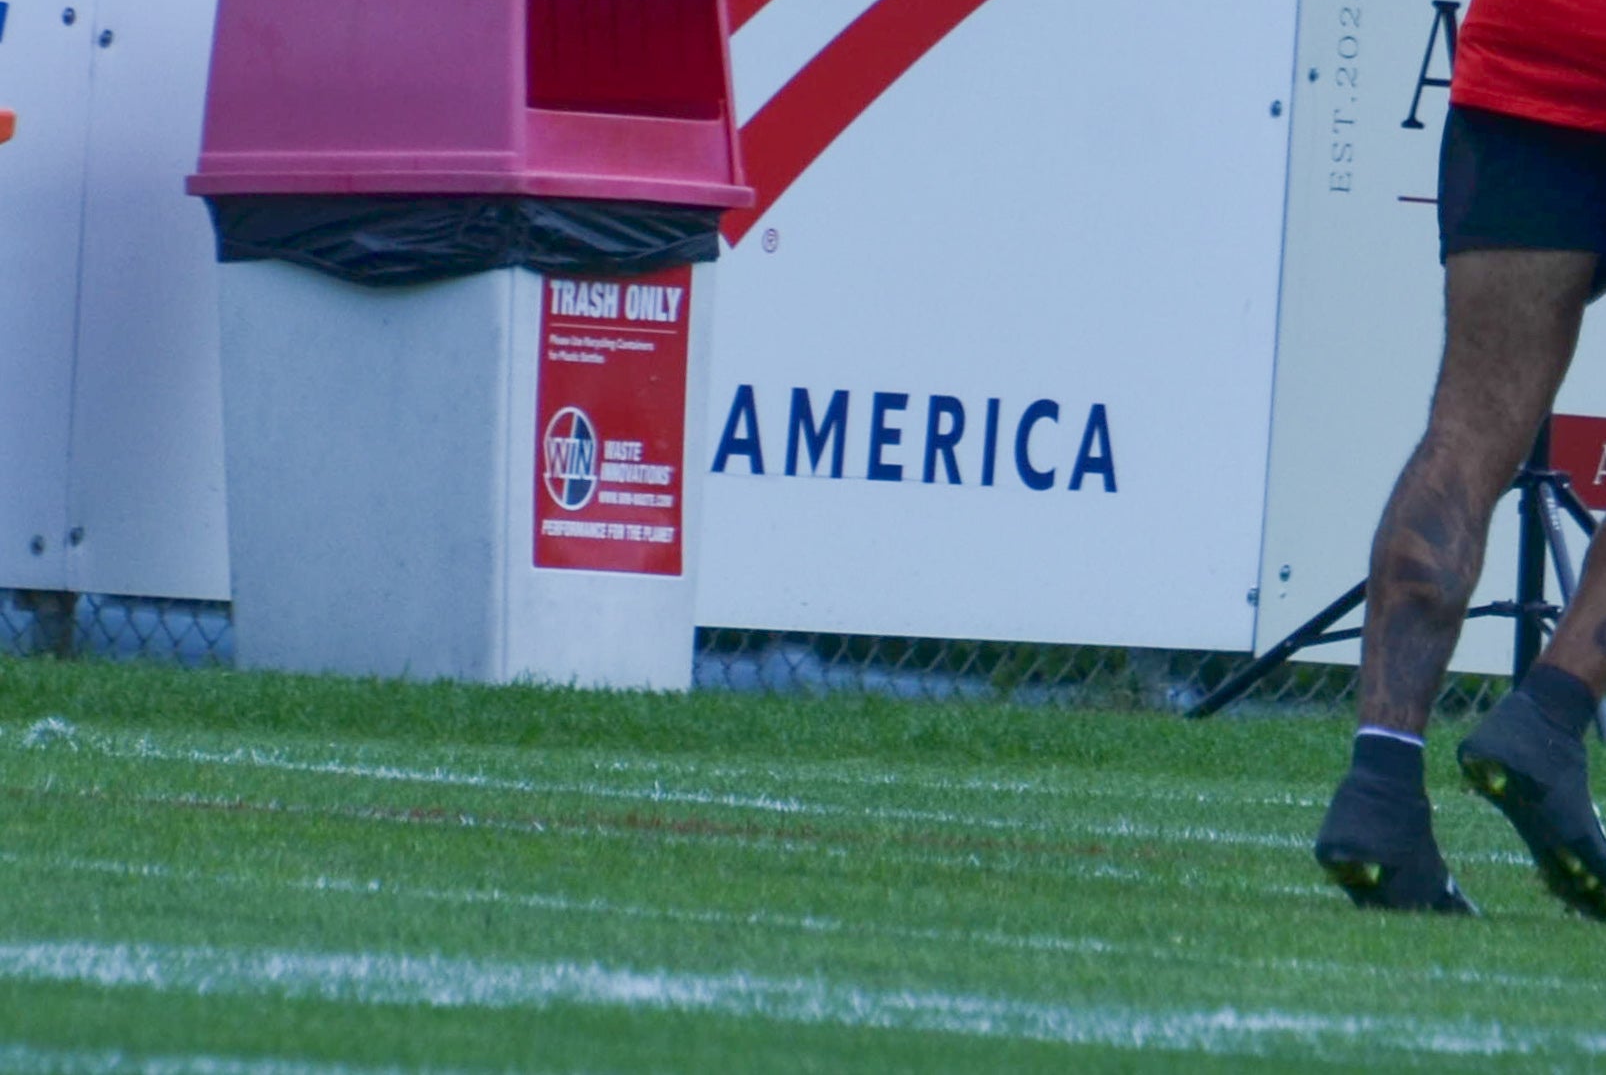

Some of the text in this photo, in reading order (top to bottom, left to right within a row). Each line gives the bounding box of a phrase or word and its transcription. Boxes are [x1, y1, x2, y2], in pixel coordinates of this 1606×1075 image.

[550, 280, 682, 322] TRASH ONLY
[545, 437, 597, 480] WIN
[604, 440, 643, 461] WASTE
[711, 384, 1118, 493] AMERICA
